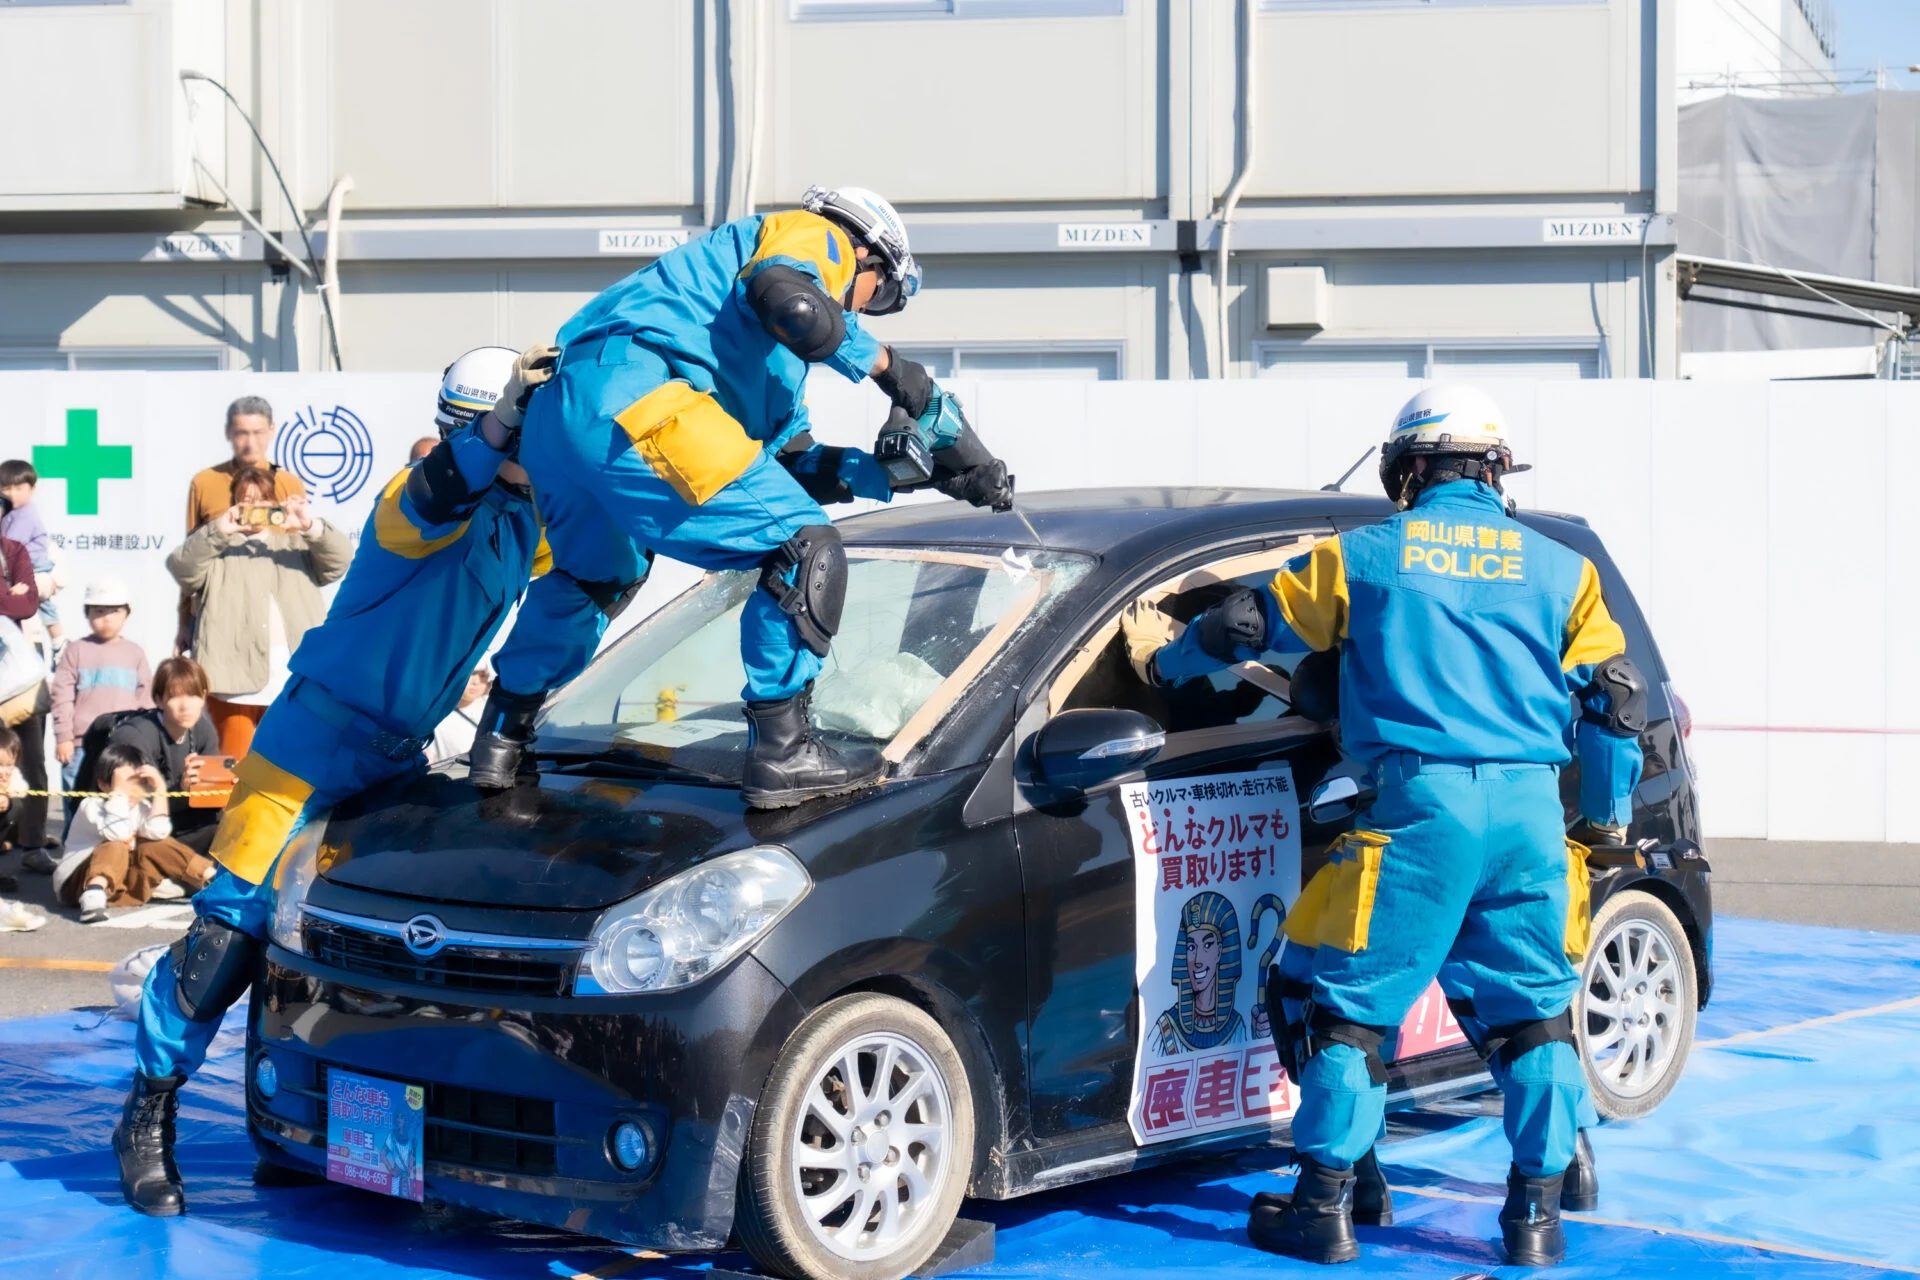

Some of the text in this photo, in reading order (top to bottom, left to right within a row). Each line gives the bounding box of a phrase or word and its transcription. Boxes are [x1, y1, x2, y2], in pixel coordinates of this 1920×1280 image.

[1065, 228, 1145, 242] MIZDEN
[1550, 222, 1634, 237] MIZDEN
[162, 240, 234, 253] MIZDEN
[606, 234, 681, 248] MIZDEN
[1407, 521, 1523, 551] 岡山県警察
[1404, 545, 1523, 580] POLICE
[1140, 808, 1289, 854] どんなクルマも
[331, 1080, 391, 1109] どんな車も
